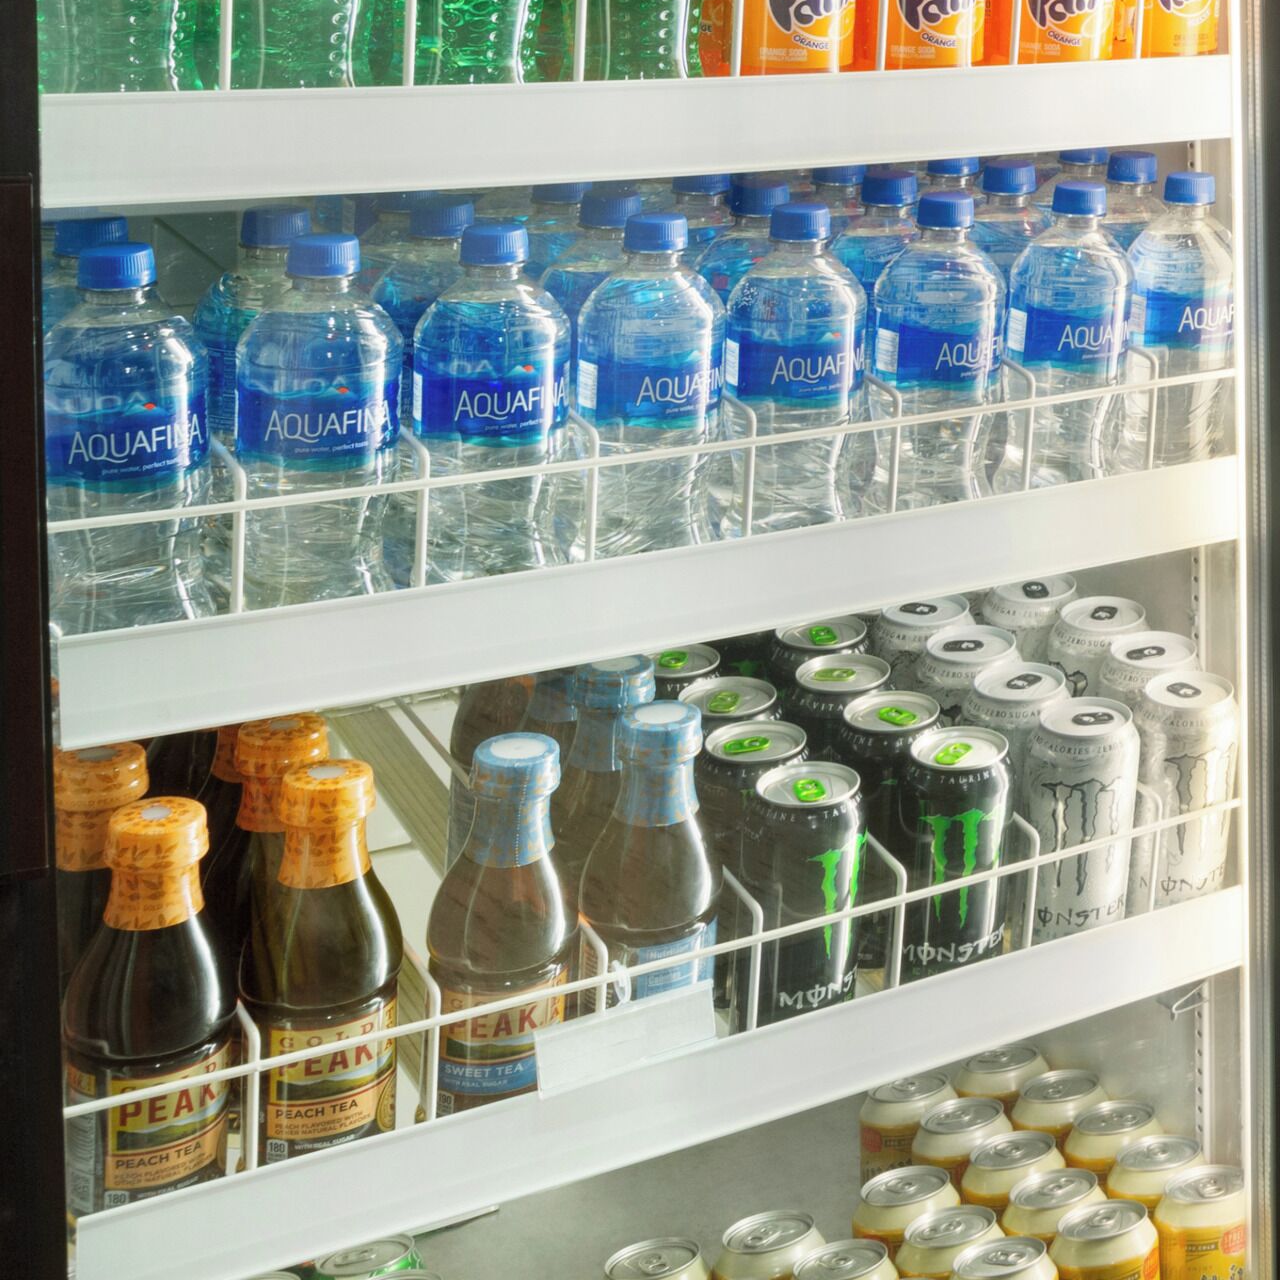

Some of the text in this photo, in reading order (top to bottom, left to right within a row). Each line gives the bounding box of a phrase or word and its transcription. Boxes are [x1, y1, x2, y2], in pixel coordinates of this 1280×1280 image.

[793, 33, 830, 51] ORANGE
[922, 32, 958, 48] ORANGE
[1047, 30, 1082, 47] ORANGE
[771, 347, 865, 386] AQUAFNA
[264, 397, 392, 444] AQUAFINA
[68, 413, 203, 467] AQUAFINA
[332, 441, 353, 453] perfect
[142, 459, 166, 471] perfect
[1037, 893, 1125, 928] ONSTER
[450, 1005, 538, 1039] PEAK
[279, 1022, 374, 1049] GOLD
[278, 1043, 374, 1077] PEAK
[443, 1062, 525, 1079] SWEET TEA
[120, 1082, 217, 1127] PEAK
[275, 1099, 359, 1120] PEACH TEA
[438, 1092, 452, 1106] 190
[115, 1142, 203, 1170] PEACH TEA
[269, 1142, 286, 1154] 180
[106, 1192, 127, 1205] 180
